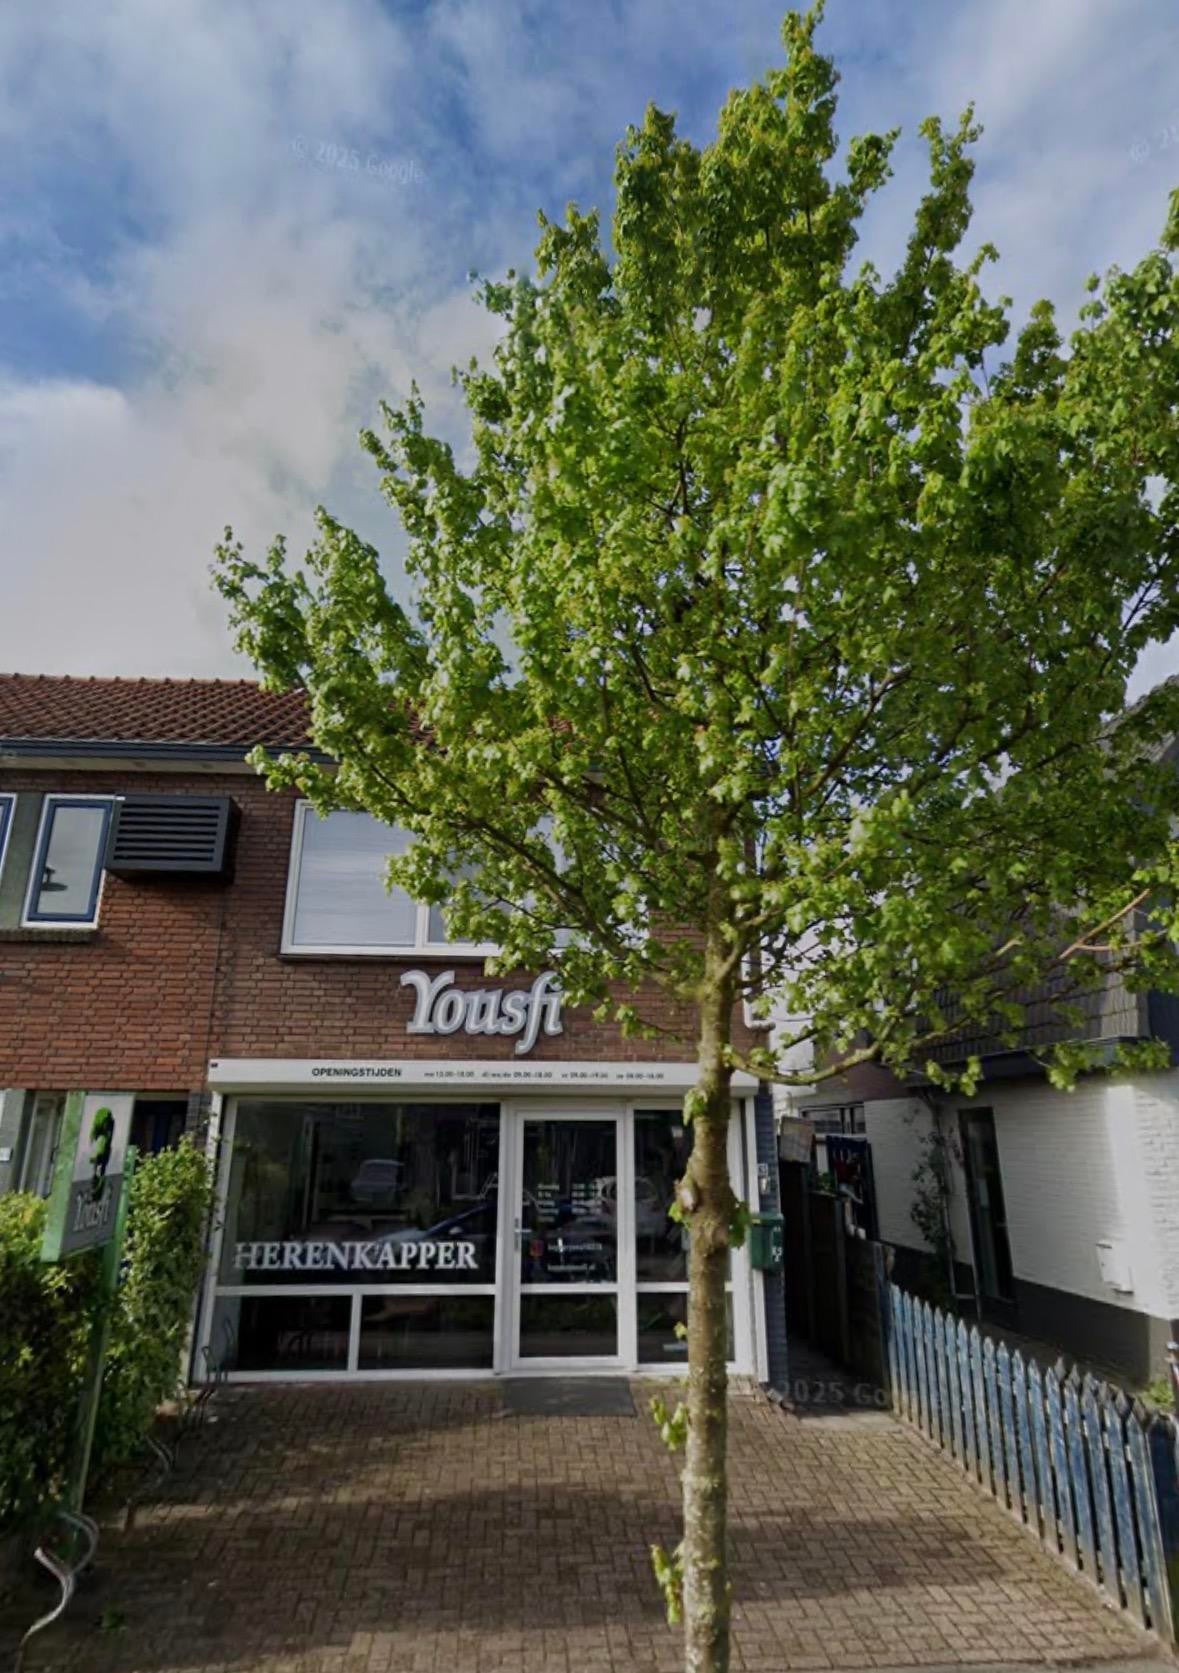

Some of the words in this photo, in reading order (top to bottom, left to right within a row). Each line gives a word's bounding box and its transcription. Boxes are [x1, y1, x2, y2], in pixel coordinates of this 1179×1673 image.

[401, 970, 564, 1055] Yousfi
[312, 1068, 402, 1077] OPENINGSTIJDEN
[234, 1241, 478, 1270] HERENKAPPER
